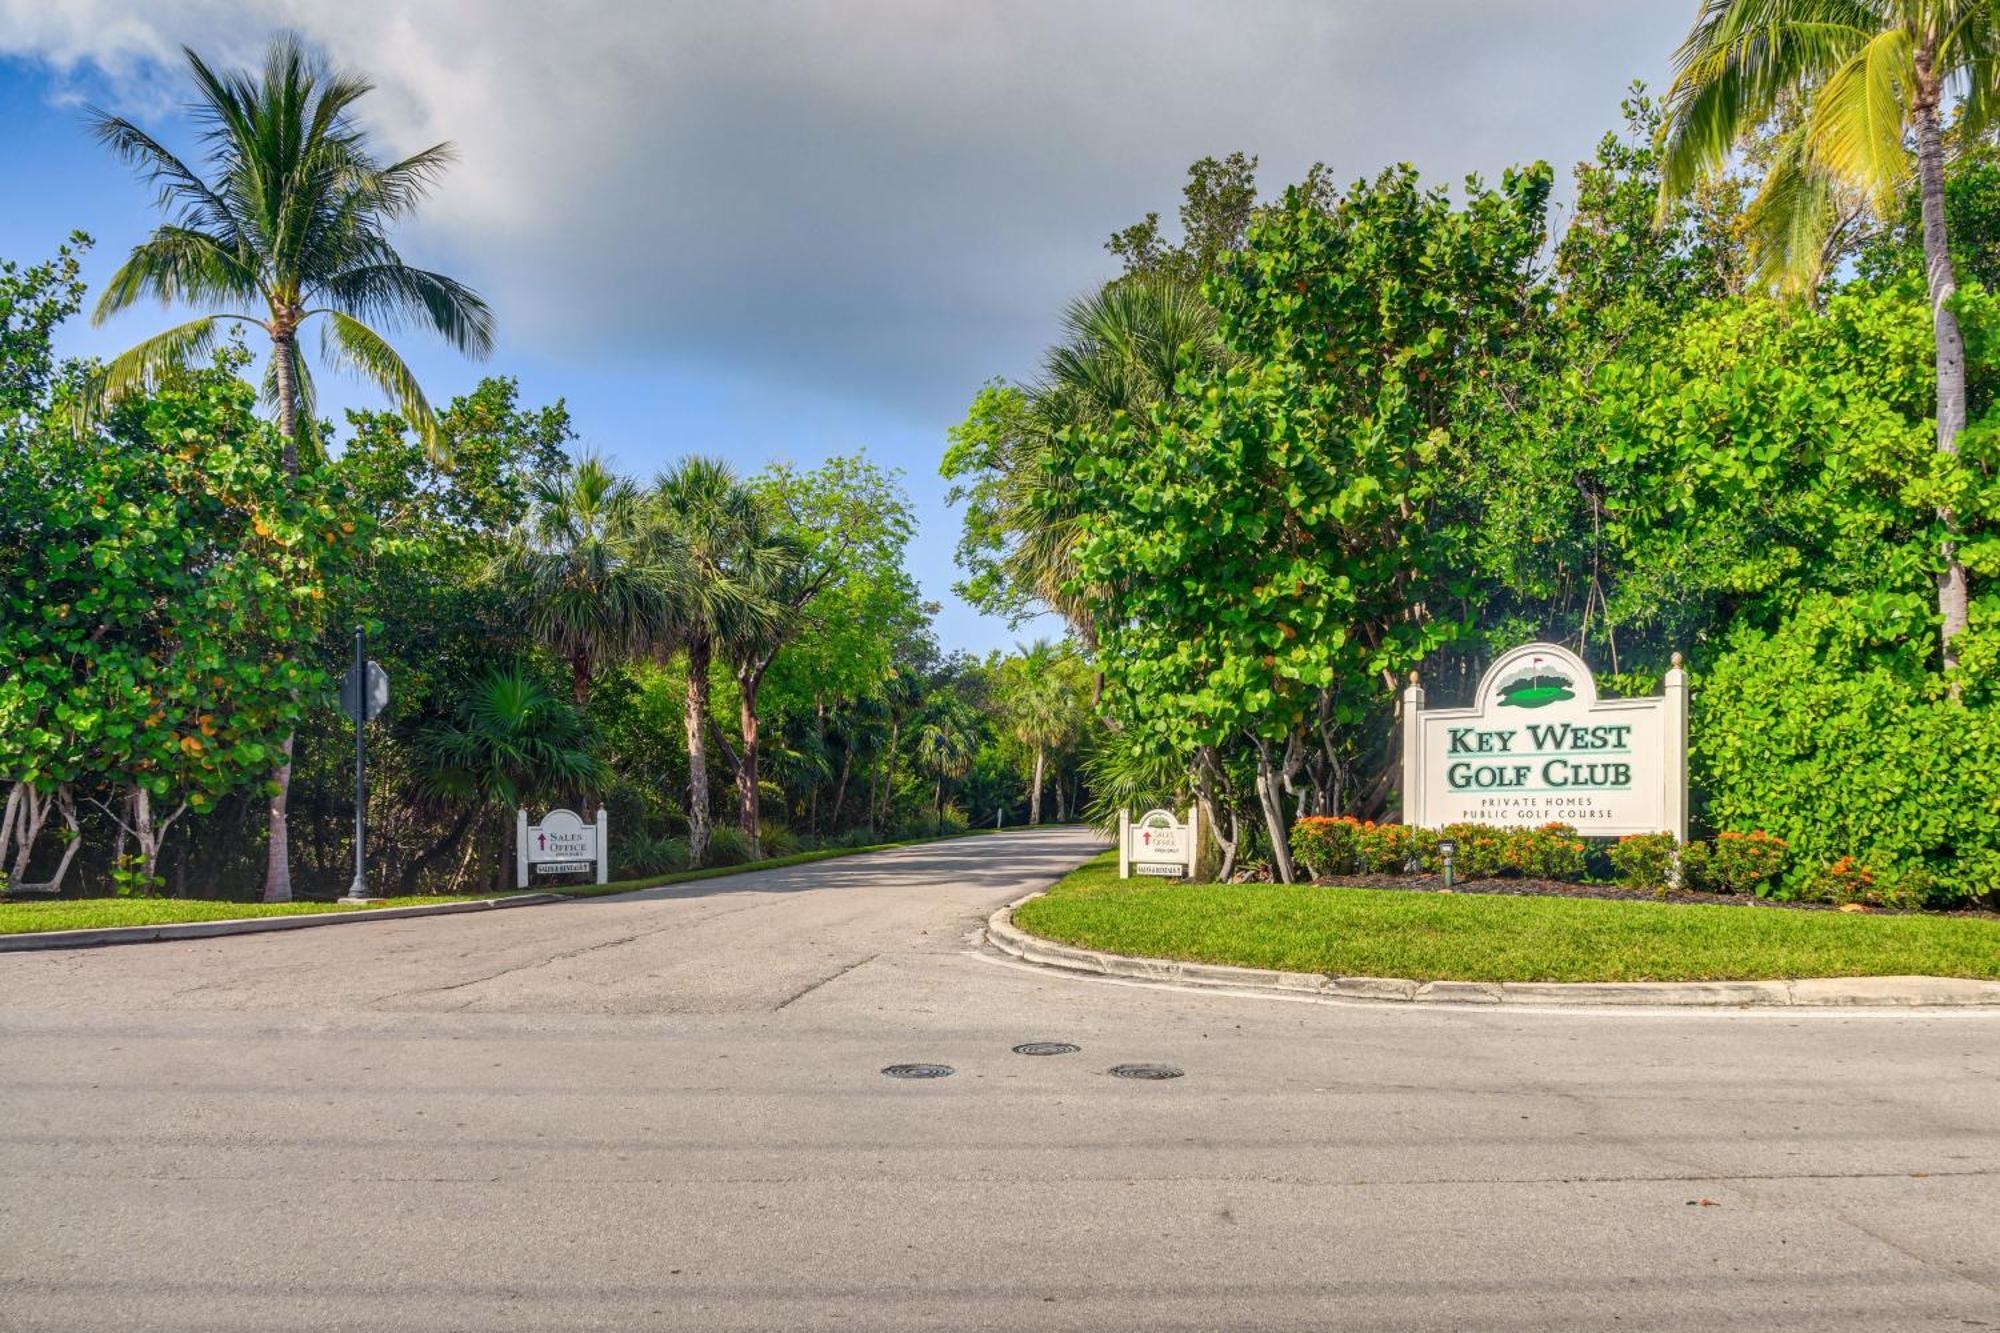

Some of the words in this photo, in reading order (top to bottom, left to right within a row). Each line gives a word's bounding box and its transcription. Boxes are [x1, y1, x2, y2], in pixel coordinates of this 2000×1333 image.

[1481, 798, 1537, 807] PRIVATE
[1546, 797, 1593, 806] HOMES
[1463, 810, 1508, 819] PUBLIC
[1518, 809, 1550, 819] GOLF
[1558, 809, 1613, 819] COURSE
